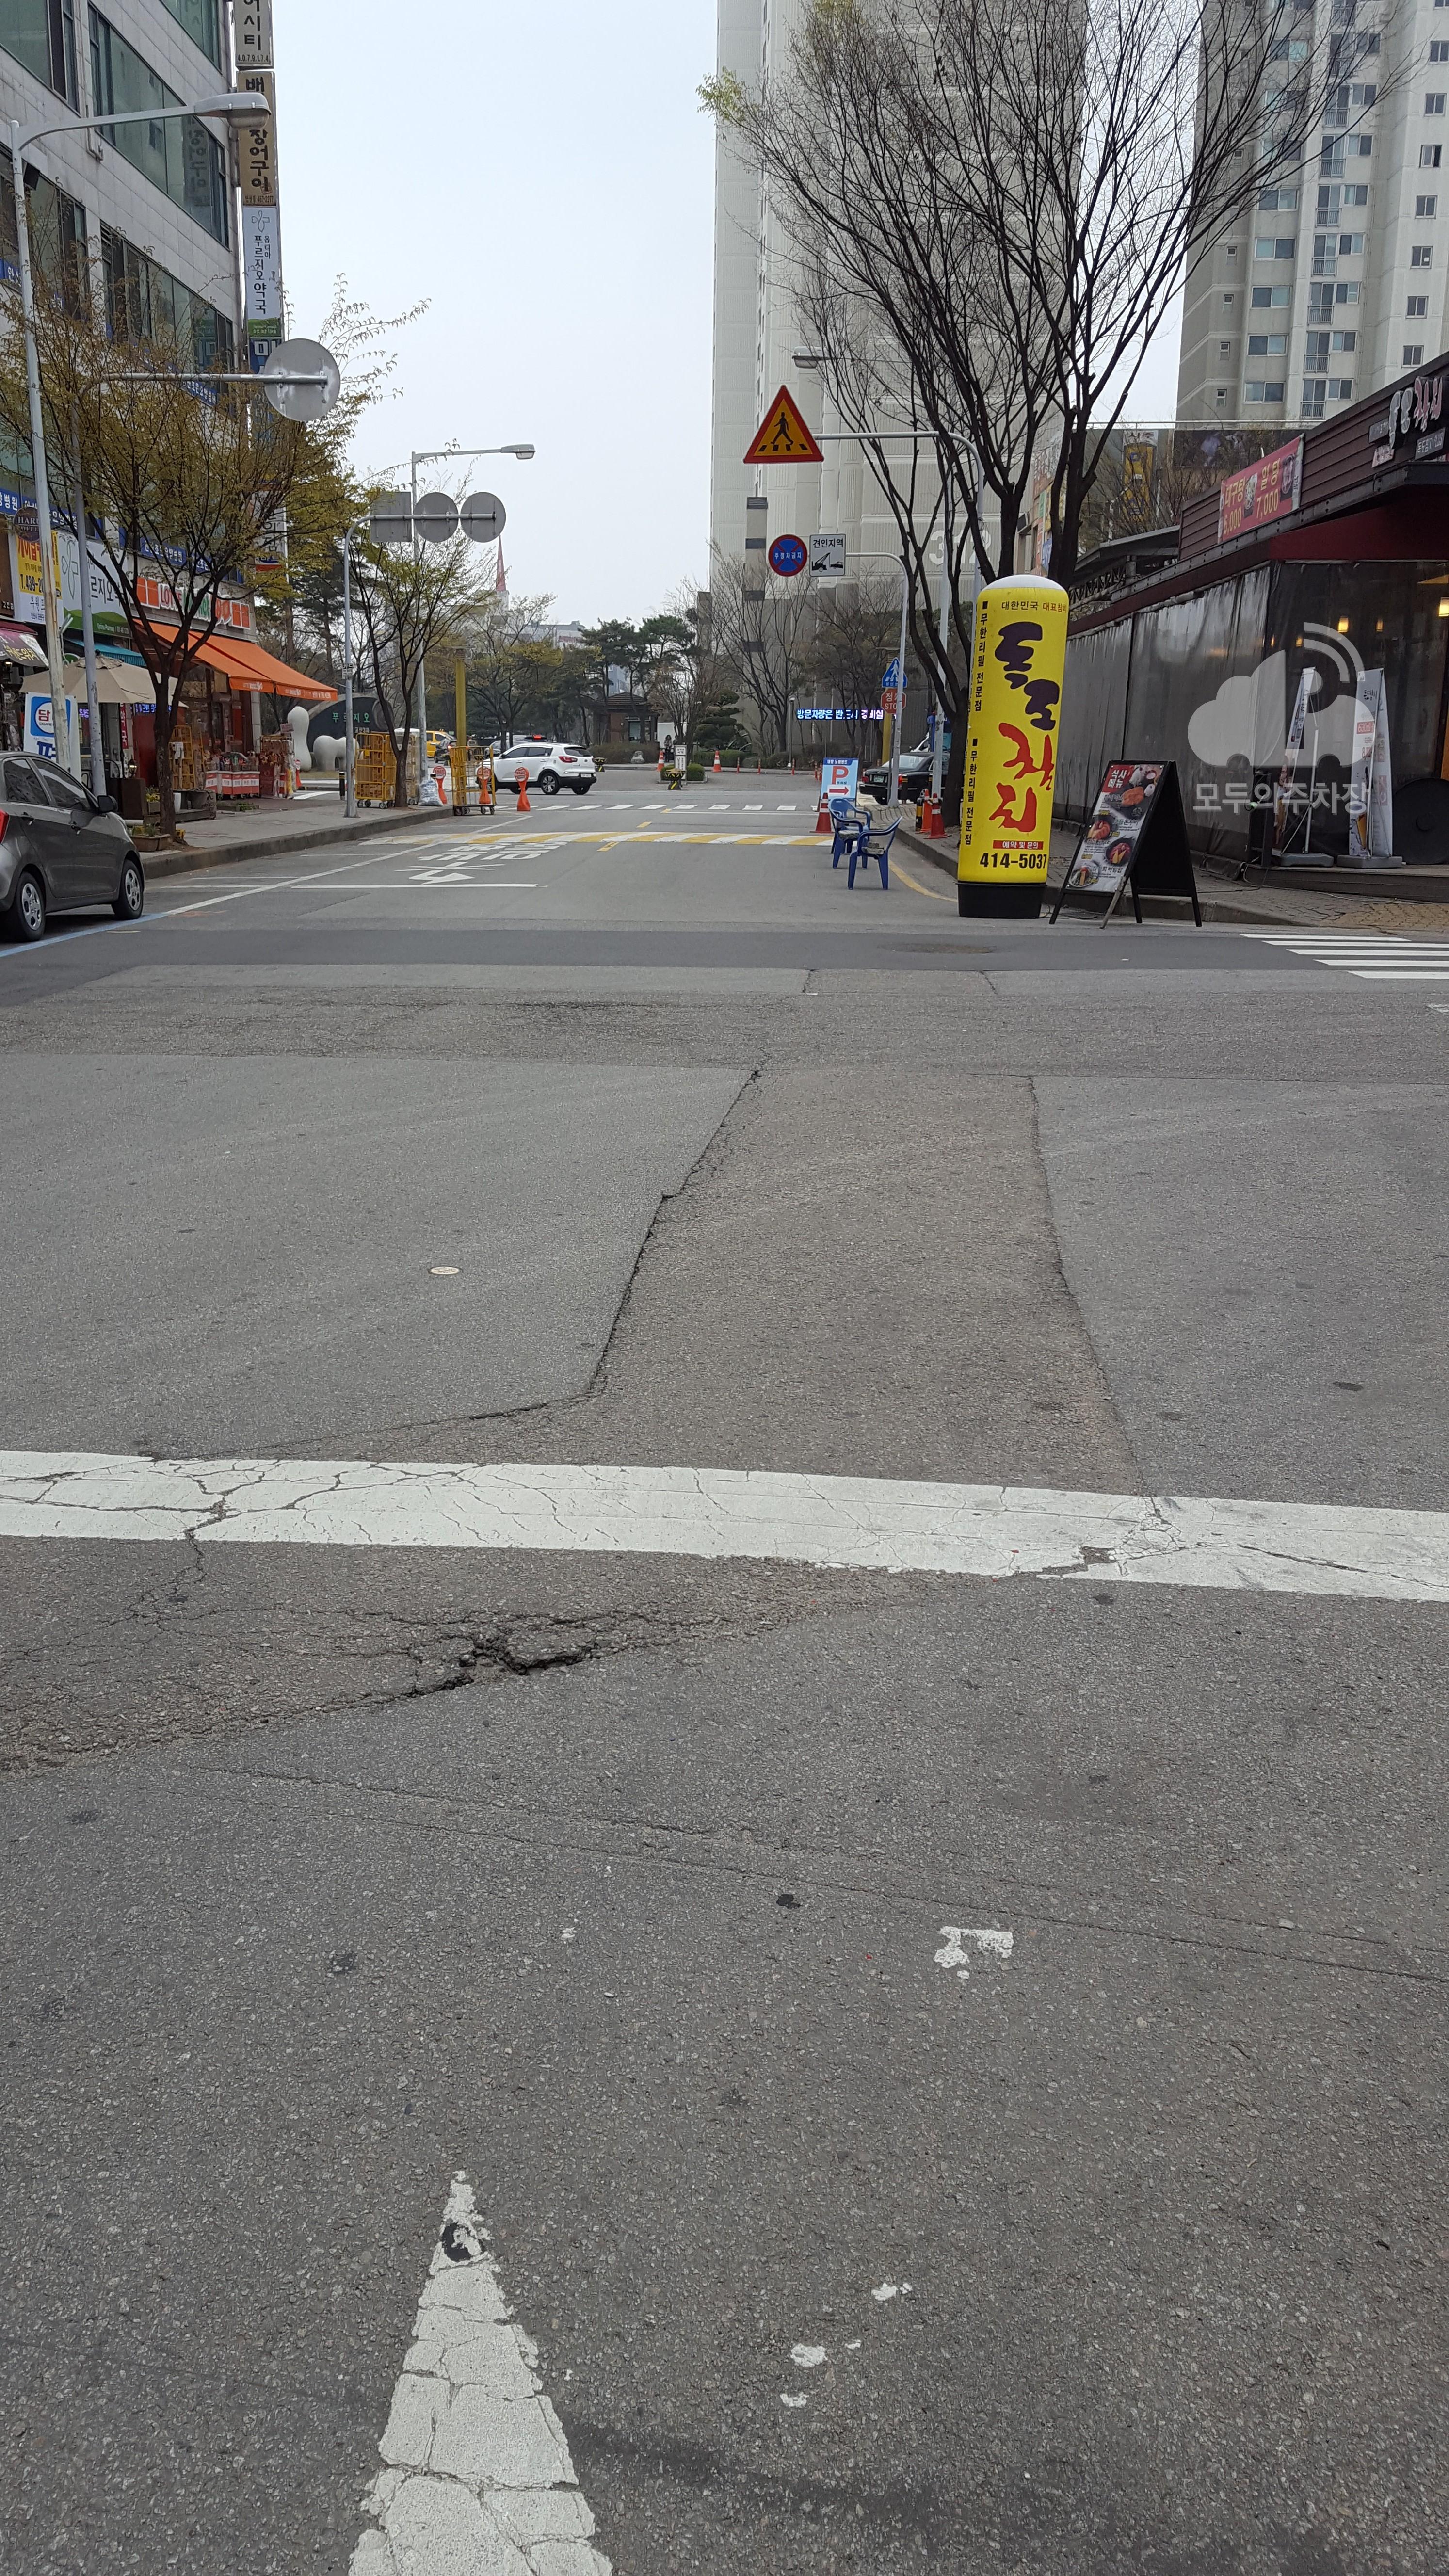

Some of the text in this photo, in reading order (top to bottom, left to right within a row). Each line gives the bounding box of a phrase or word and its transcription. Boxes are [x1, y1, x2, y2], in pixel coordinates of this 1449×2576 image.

[1225, 476, 1246, 508] 대구탕
[1256, 489, 1279, 519] 7,000
[813, 538, 843, 548] 견인지역
[1001, 601, 1039, 611] 대한민국
[974, 613, 988, 712] 무한리필 전문점
[38, 709, 51, 722] 담
[797, 709, 833, 719] 방문차량은
[831, 766, 849, 785] P
[1111, 770, 1127, 779] 식사
[1108, 779, 1124, 789] 메뉴
[965, 751, 978, 845] 무한리필 전문점
[980, 853, 1047, 869] 414-5037
